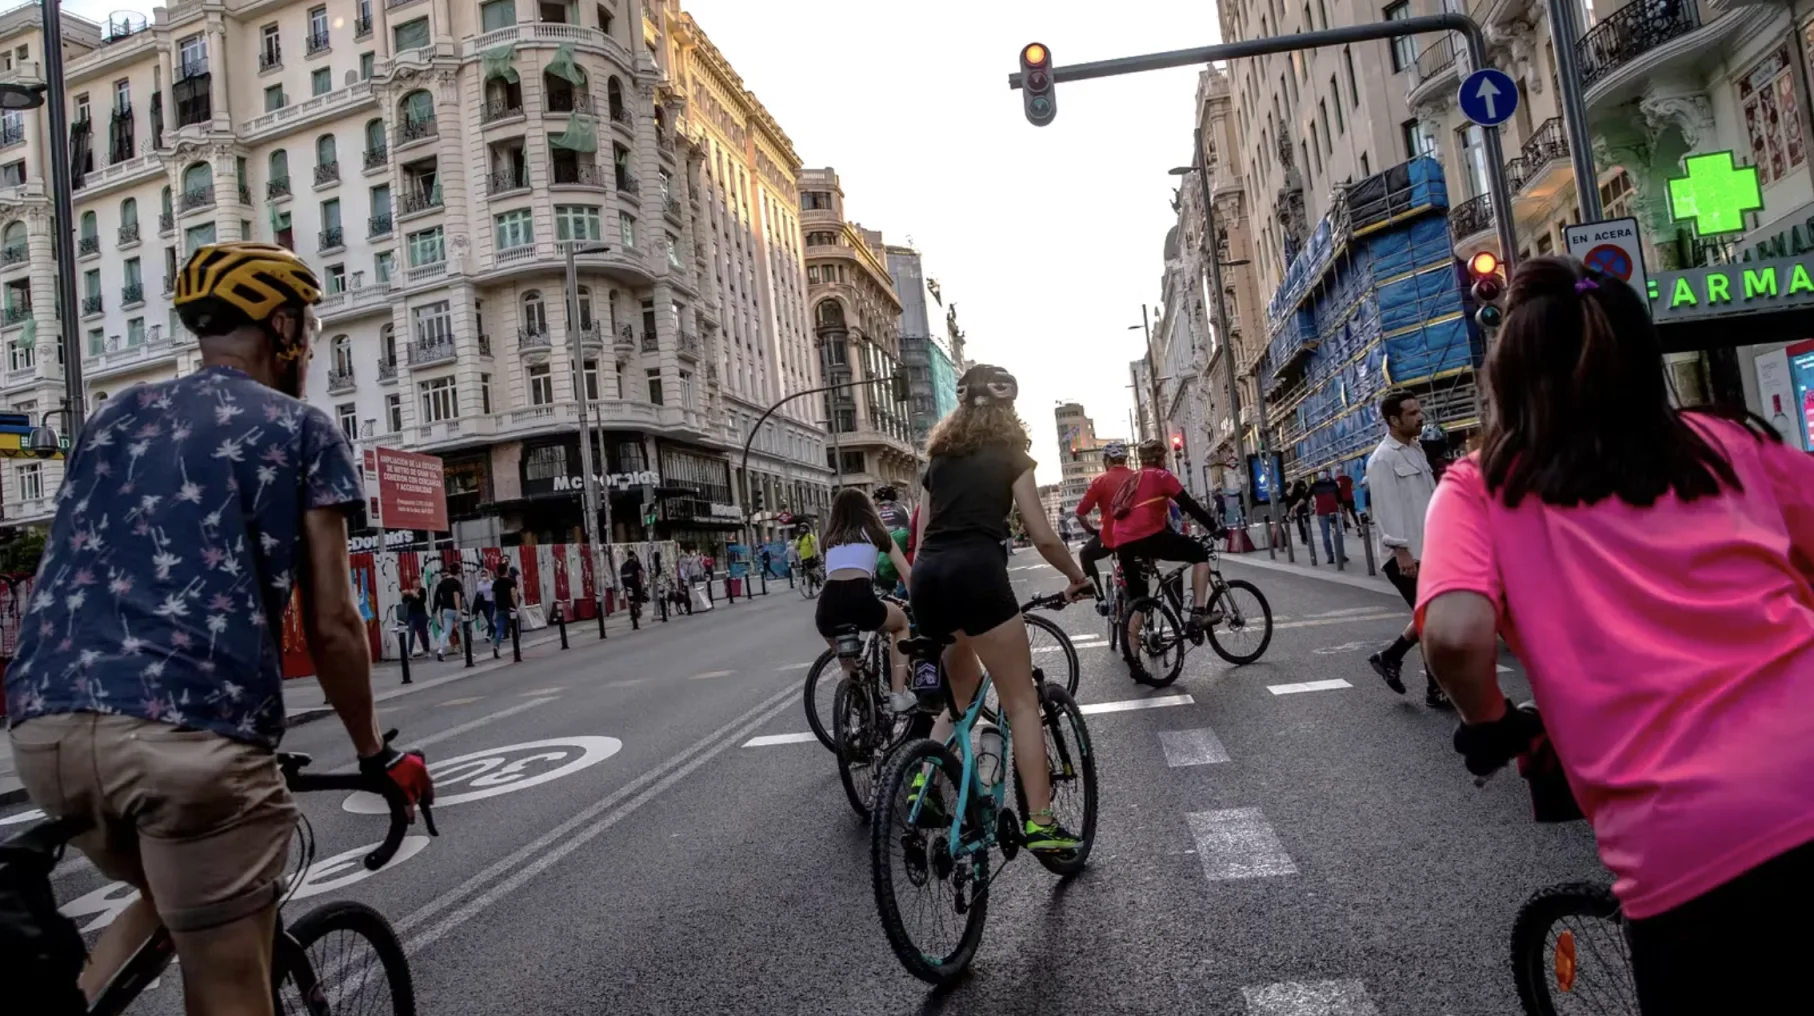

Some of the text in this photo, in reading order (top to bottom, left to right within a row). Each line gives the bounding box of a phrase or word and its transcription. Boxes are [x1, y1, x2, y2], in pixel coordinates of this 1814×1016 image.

[1572, 228, 1633, 245] EN ACERA
[553, 470, 660, 491] Mconald's
